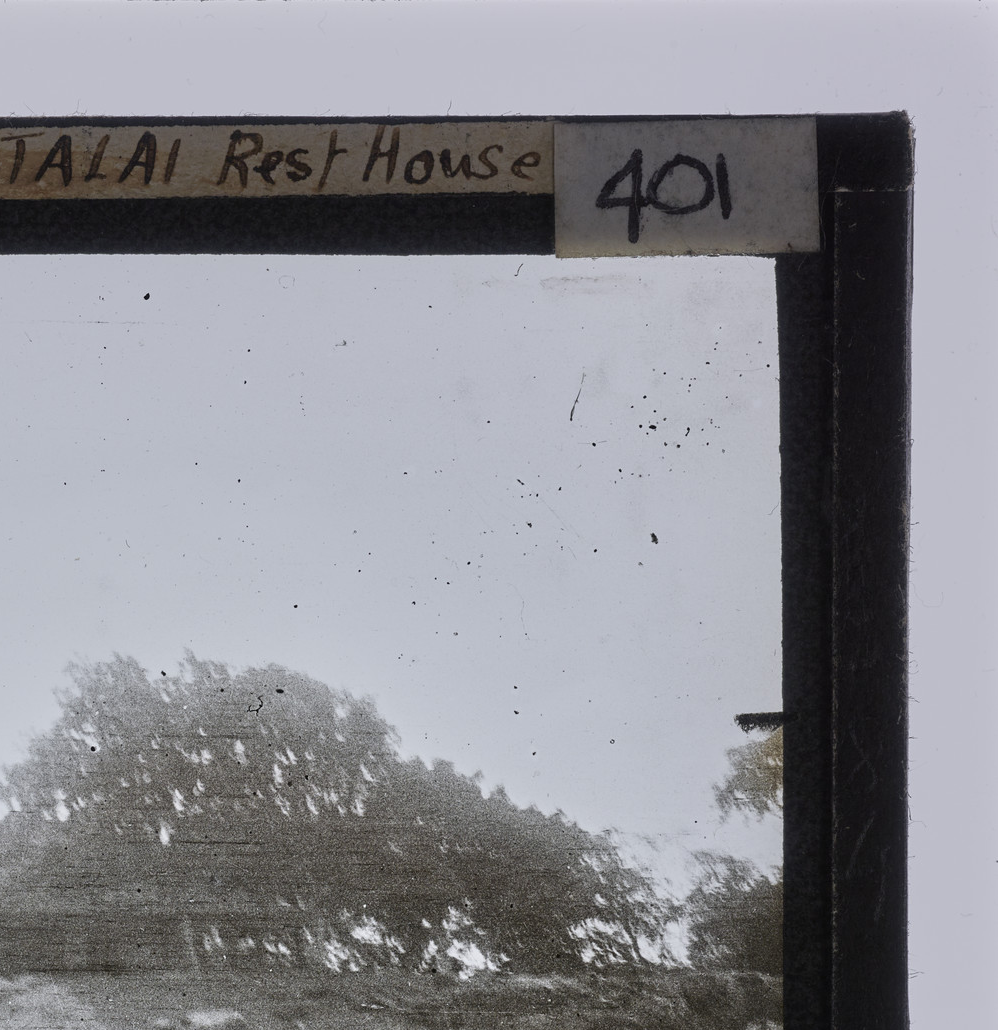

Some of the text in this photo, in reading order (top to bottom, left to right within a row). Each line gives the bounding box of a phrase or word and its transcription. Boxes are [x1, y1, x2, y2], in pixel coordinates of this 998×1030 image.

[216, 128, 348, 191] Rest
[361, 123, 542, 185] House
[595, 148, 733, 243] 401
